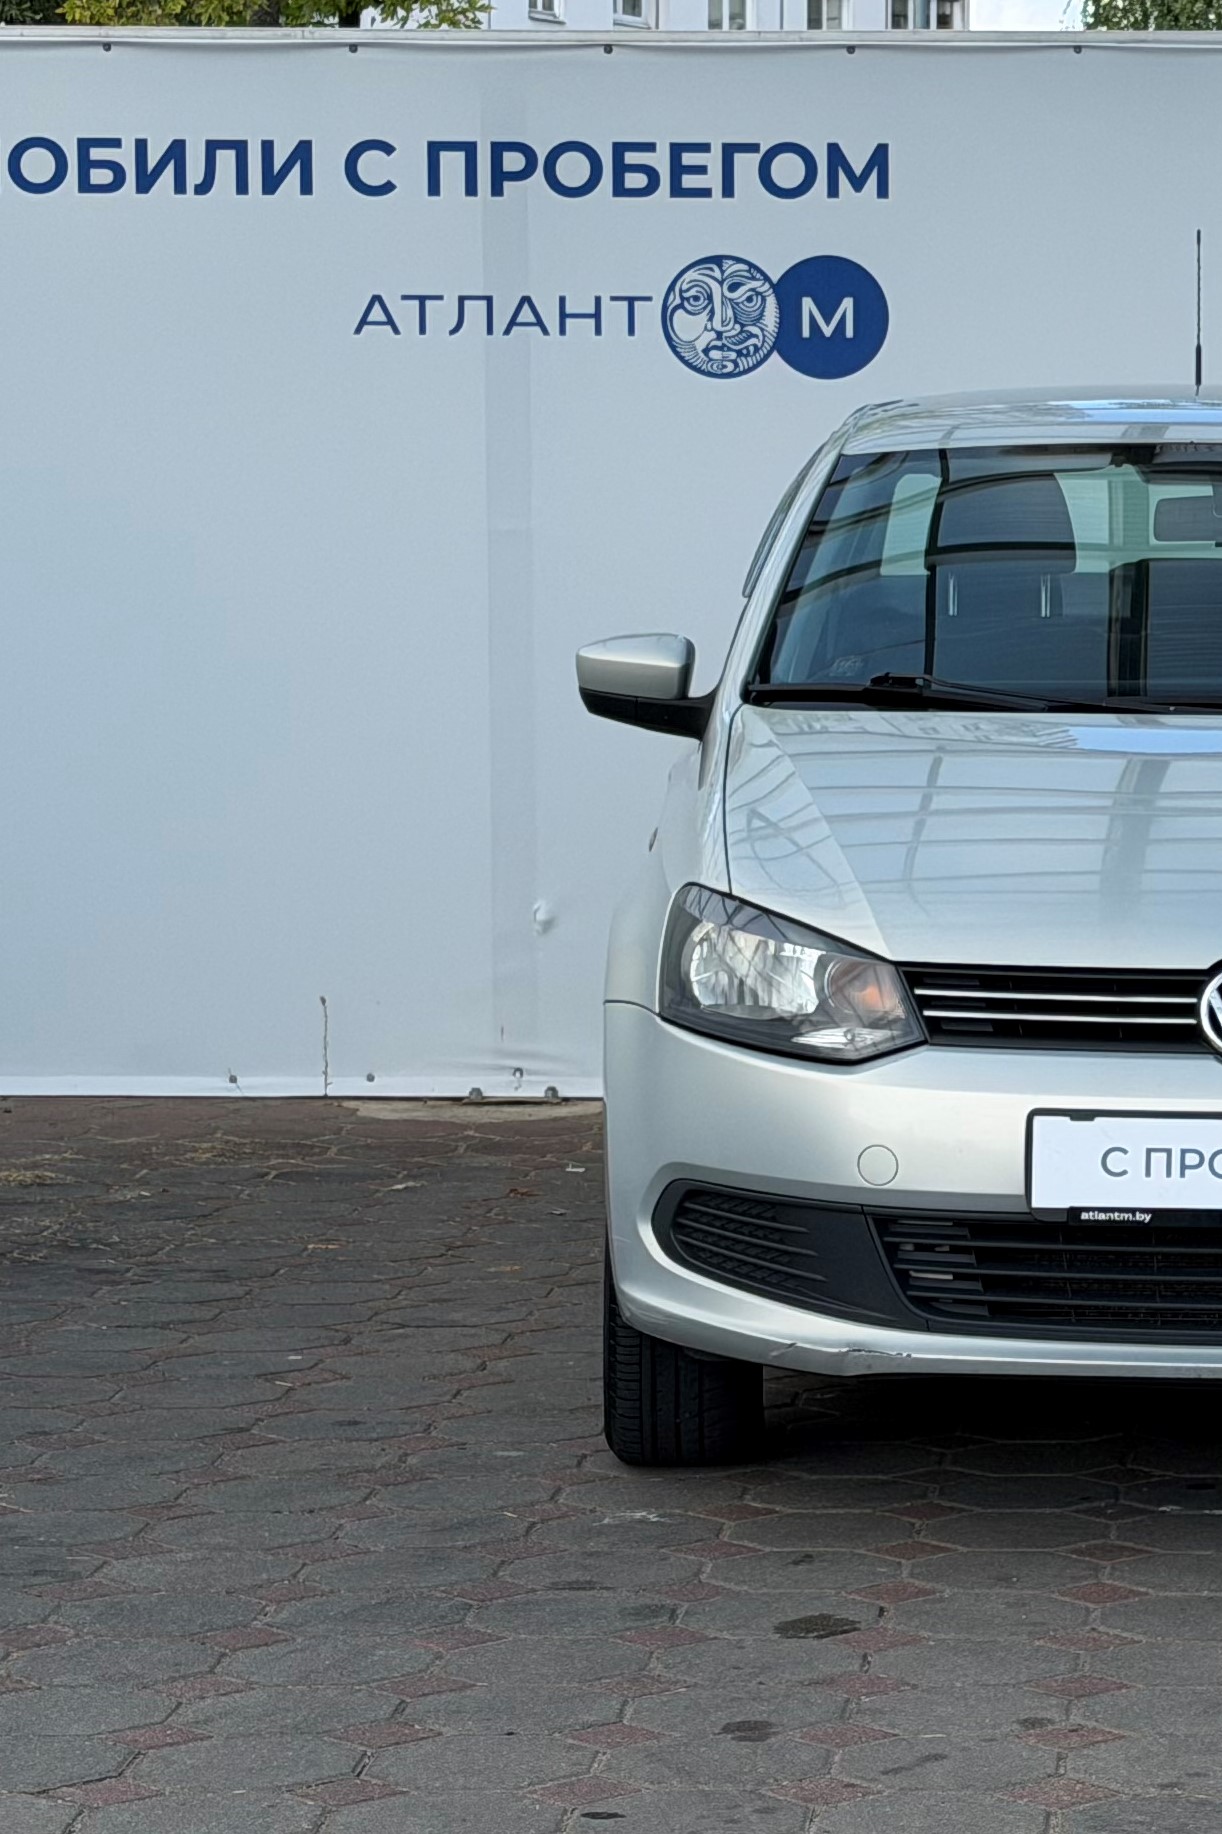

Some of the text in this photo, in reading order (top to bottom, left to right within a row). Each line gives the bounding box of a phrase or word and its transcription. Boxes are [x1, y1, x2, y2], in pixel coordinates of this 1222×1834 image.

[8, 137, 889, 199] ОБИЛИ С ПРОБЕГОМ
[354, 294, 654, 337] АТЛАНТ
[1100, 1146, 1129, 1178] С
[1080, 1211, 1152, 1224] atlantm.by
